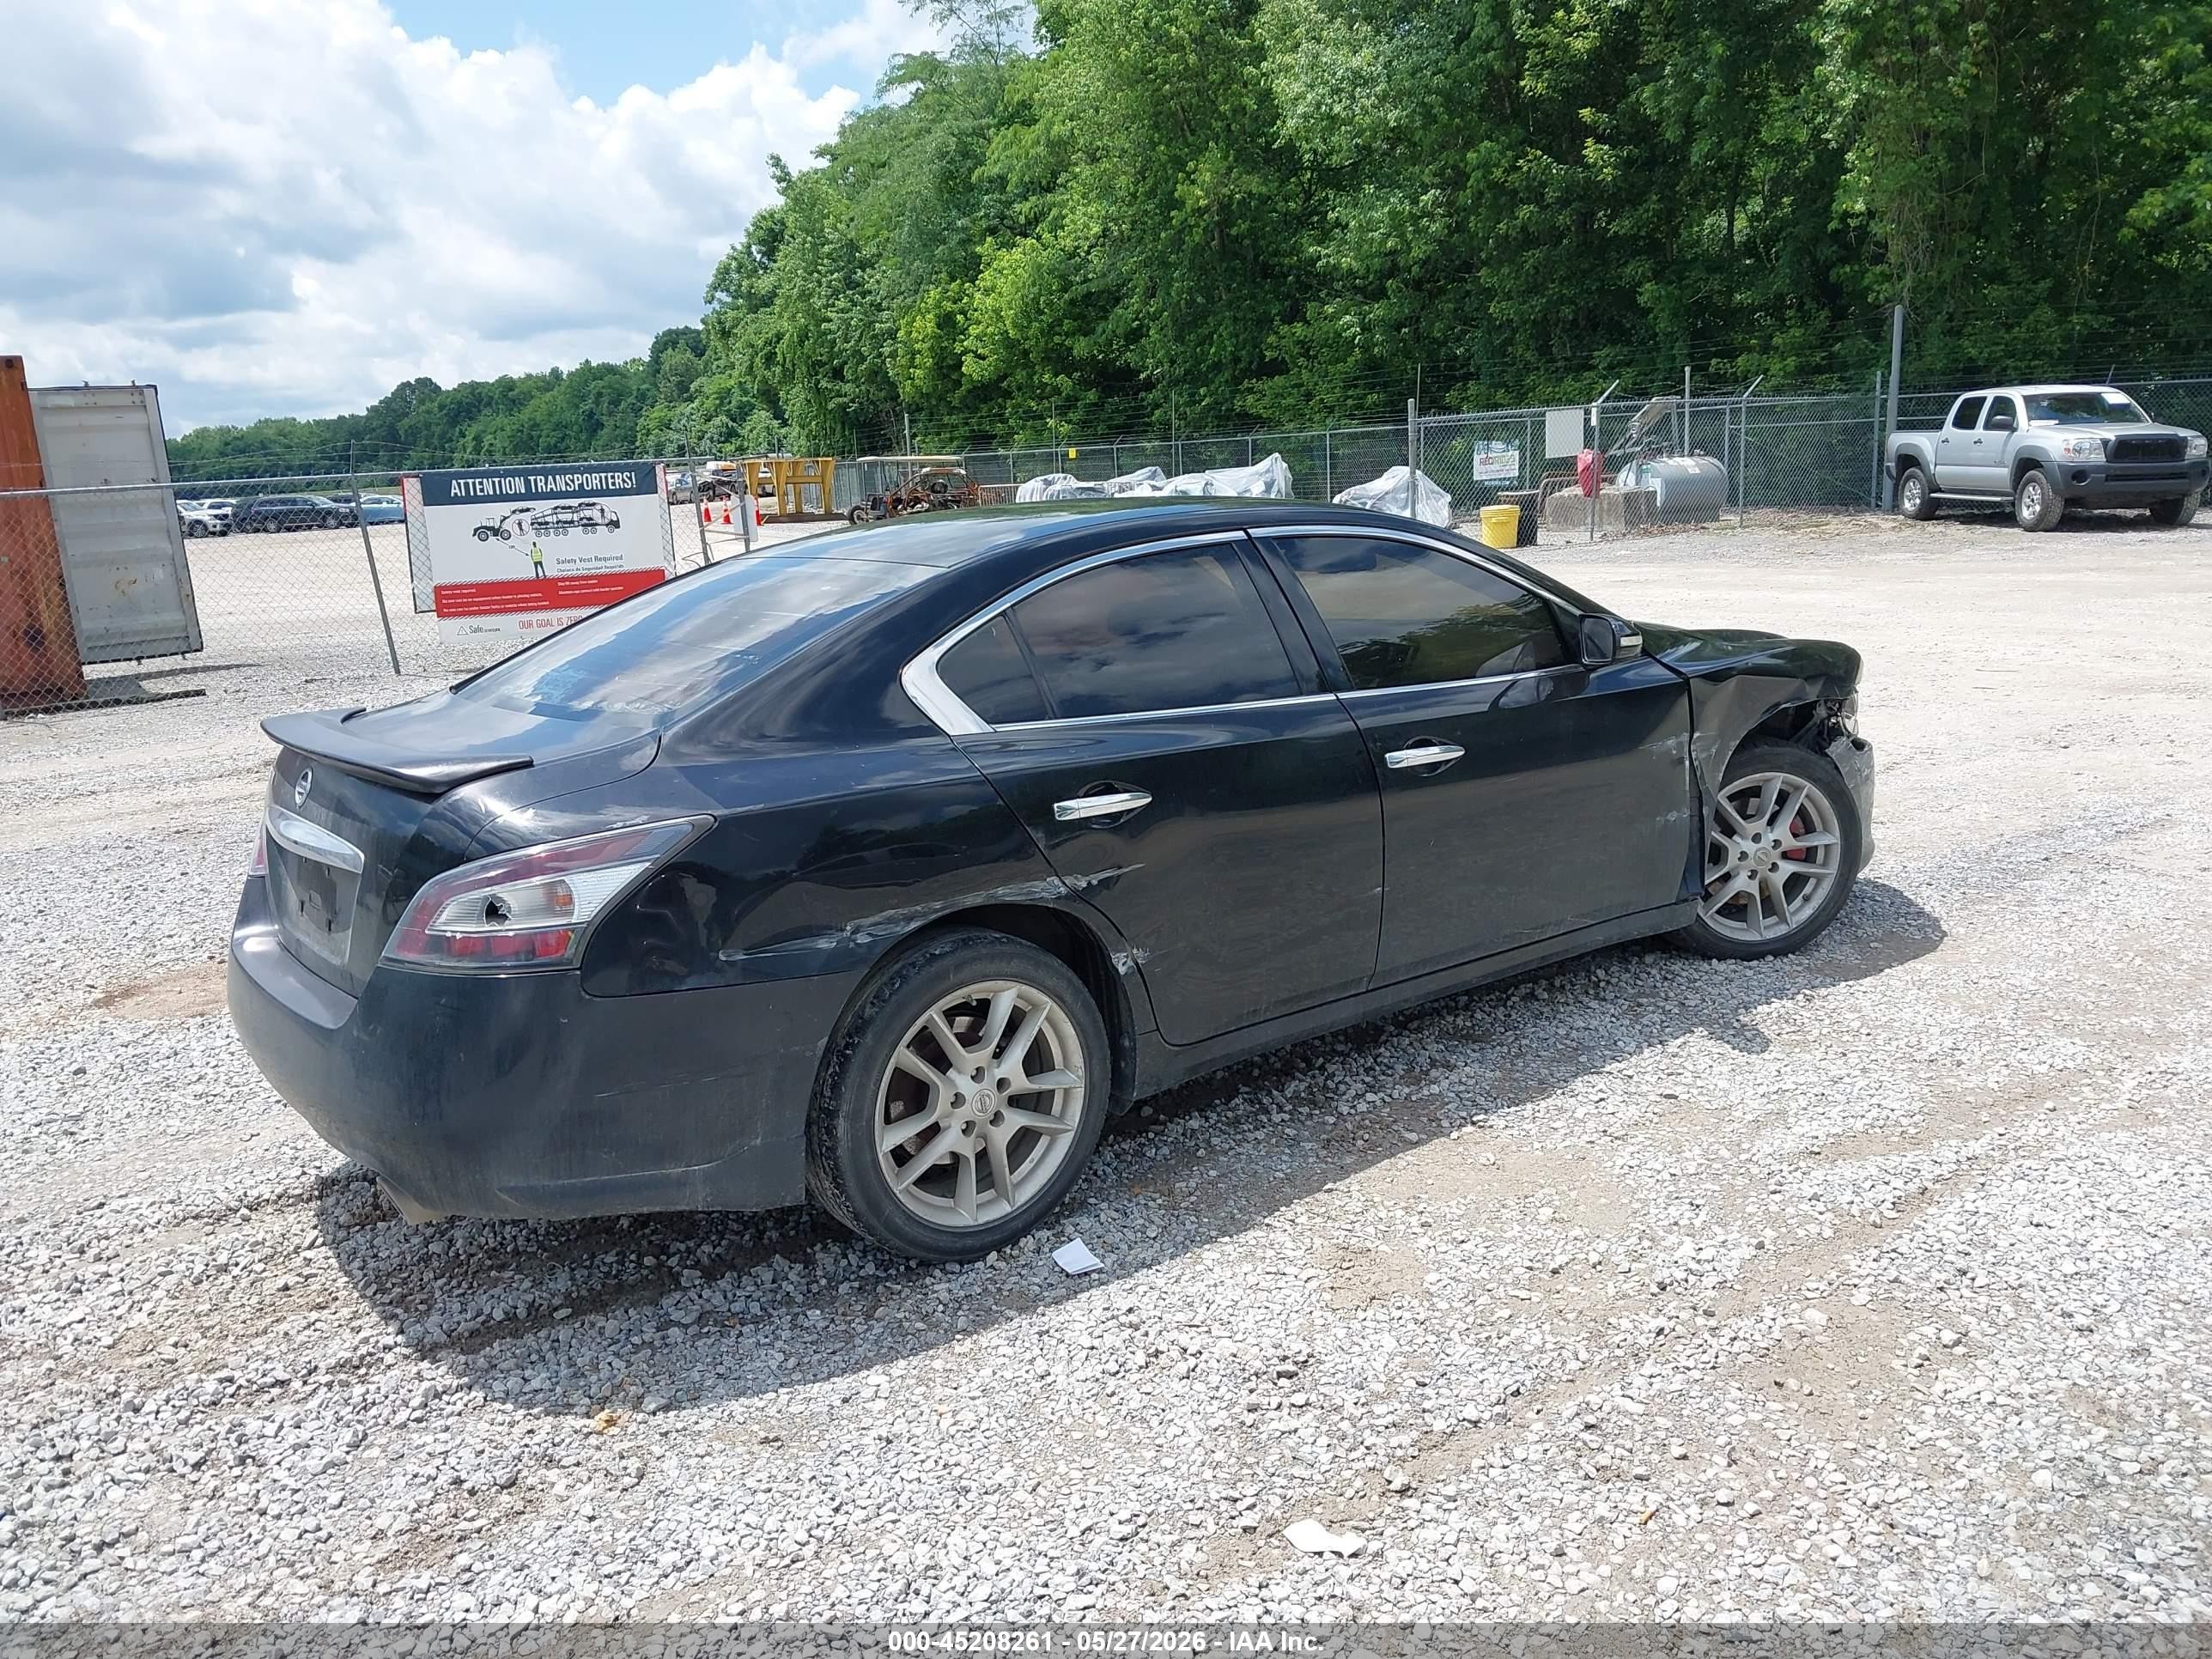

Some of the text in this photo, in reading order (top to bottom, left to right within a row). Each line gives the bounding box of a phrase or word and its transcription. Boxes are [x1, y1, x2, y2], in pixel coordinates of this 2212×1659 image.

[450, 471, 637, 497] ATTENTION TRANSPORTERS!
[593, 554, 623, 562] Required
[469, 624, 484, 635] Safe
[519, 619, 534, 630] OUR
[536, 618, 555, 629] GOAL
[556, 617, 564, 626] IS
